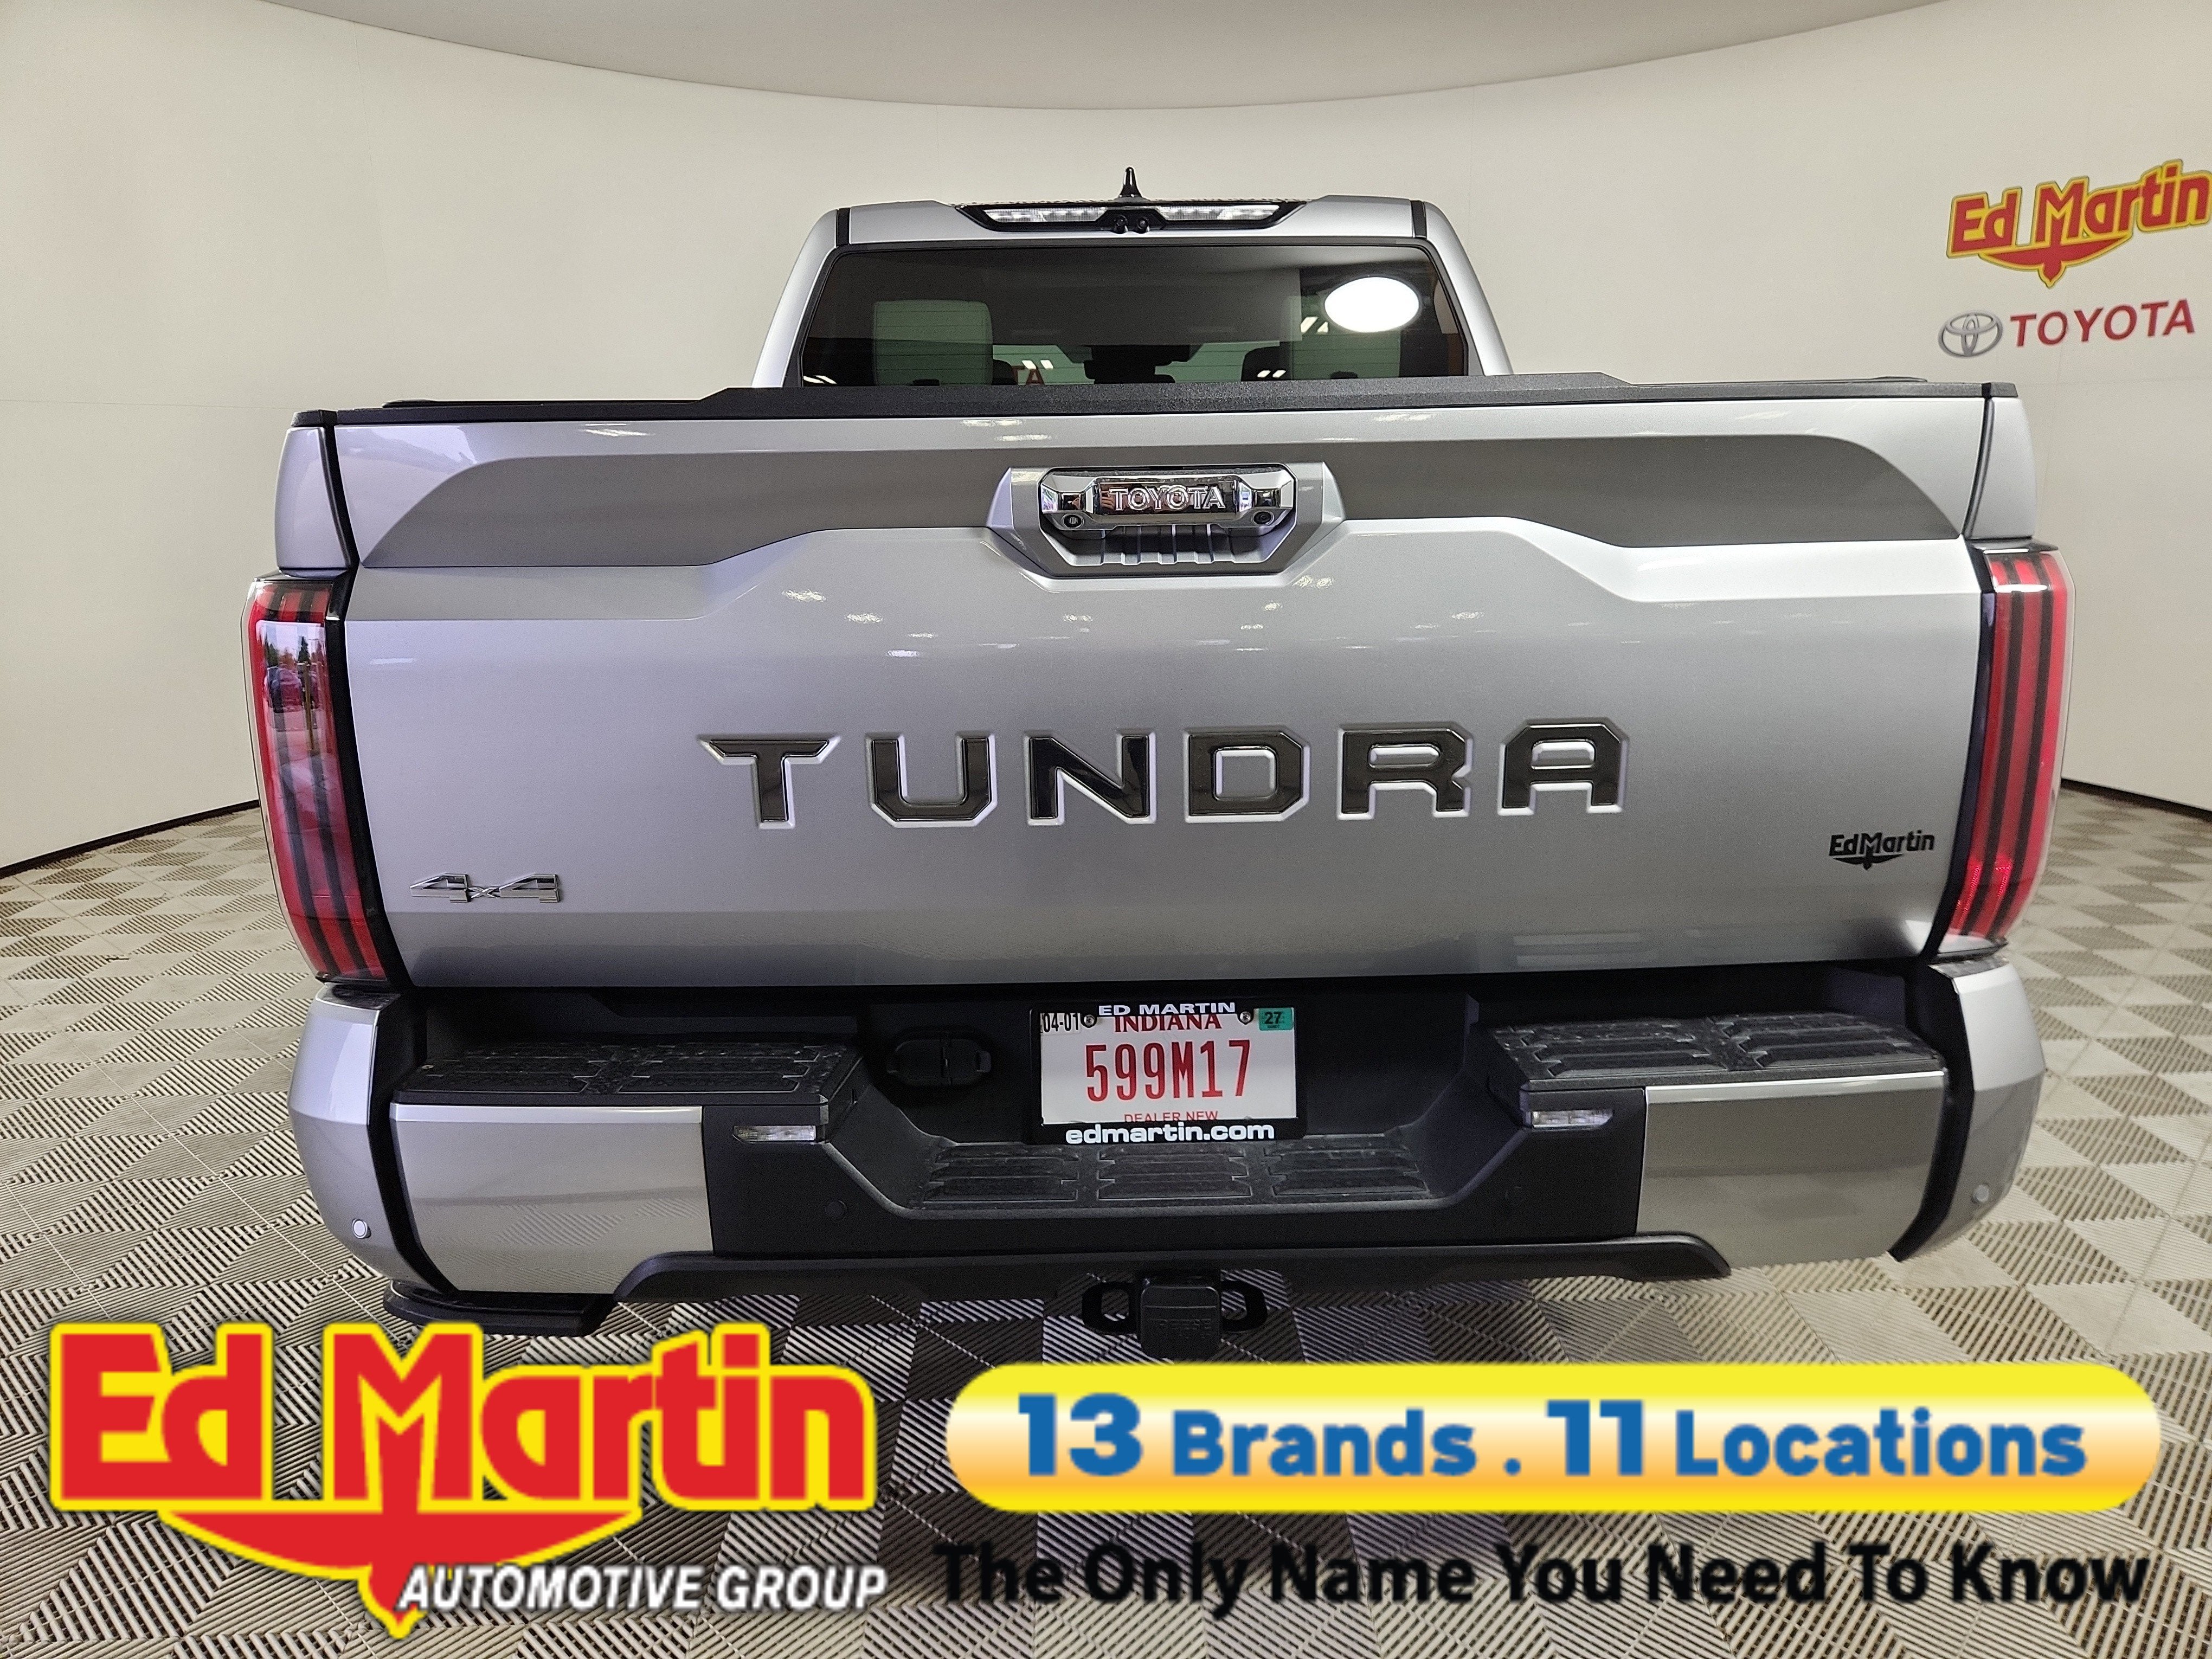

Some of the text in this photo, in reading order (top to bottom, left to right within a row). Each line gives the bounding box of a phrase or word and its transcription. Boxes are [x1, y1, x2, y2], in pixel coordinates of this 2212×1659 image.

[1949, 159, 2212, 257] Ed Martin
[2010, 299, 2195, 347] TOYOTA
[1109, 485, 1225, 511] TOYOTA
[698, 717, 1629, 829] TUNDRA
[1098, 1002, 1235, 1015] ED MARTIN
[1264, 1011, 1283, 1024] 27
[1043, 1013, 1079, 1032] 04-01
[1115, 1013, 1222, 1032] INDIANA
[1085, 1039, 1250, 1102] 599M17
[1124, 1111, 1218, 1122] DEALER NEW
[1066, 1122, 1275, 1144] edmartin.com
